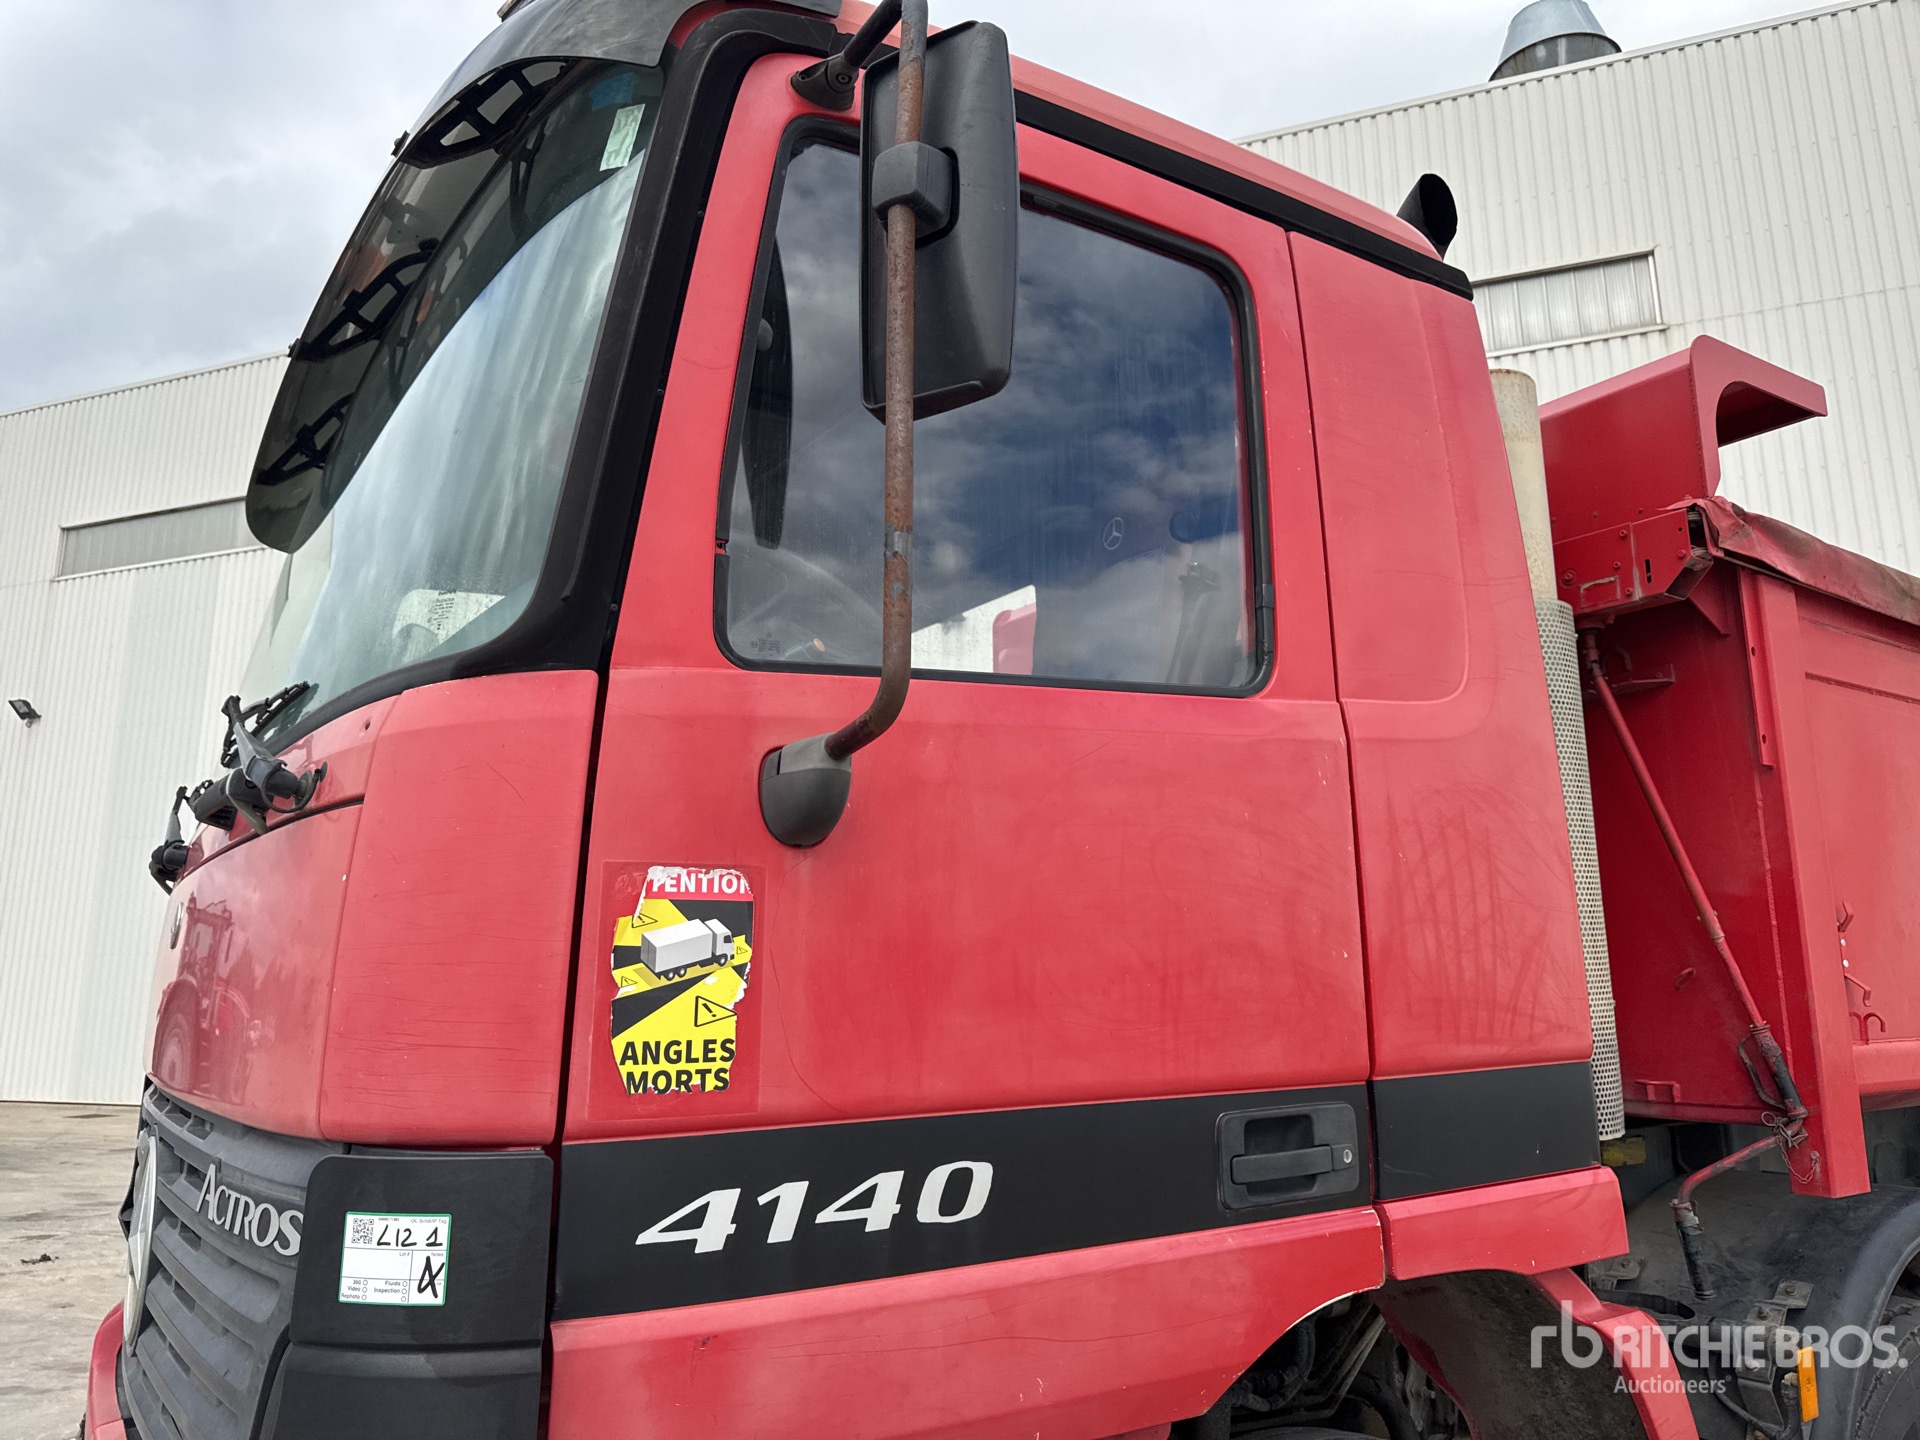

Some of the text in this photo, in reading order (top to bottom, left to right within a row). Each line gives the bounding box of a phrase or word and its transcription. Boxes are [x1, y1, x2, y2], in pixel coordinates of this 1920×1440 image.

[619, 1038, 736, 1066] ANGLES
[625, 1067, 730, 1096] MORTS
[635, 1160, 993, 1254] 4140
